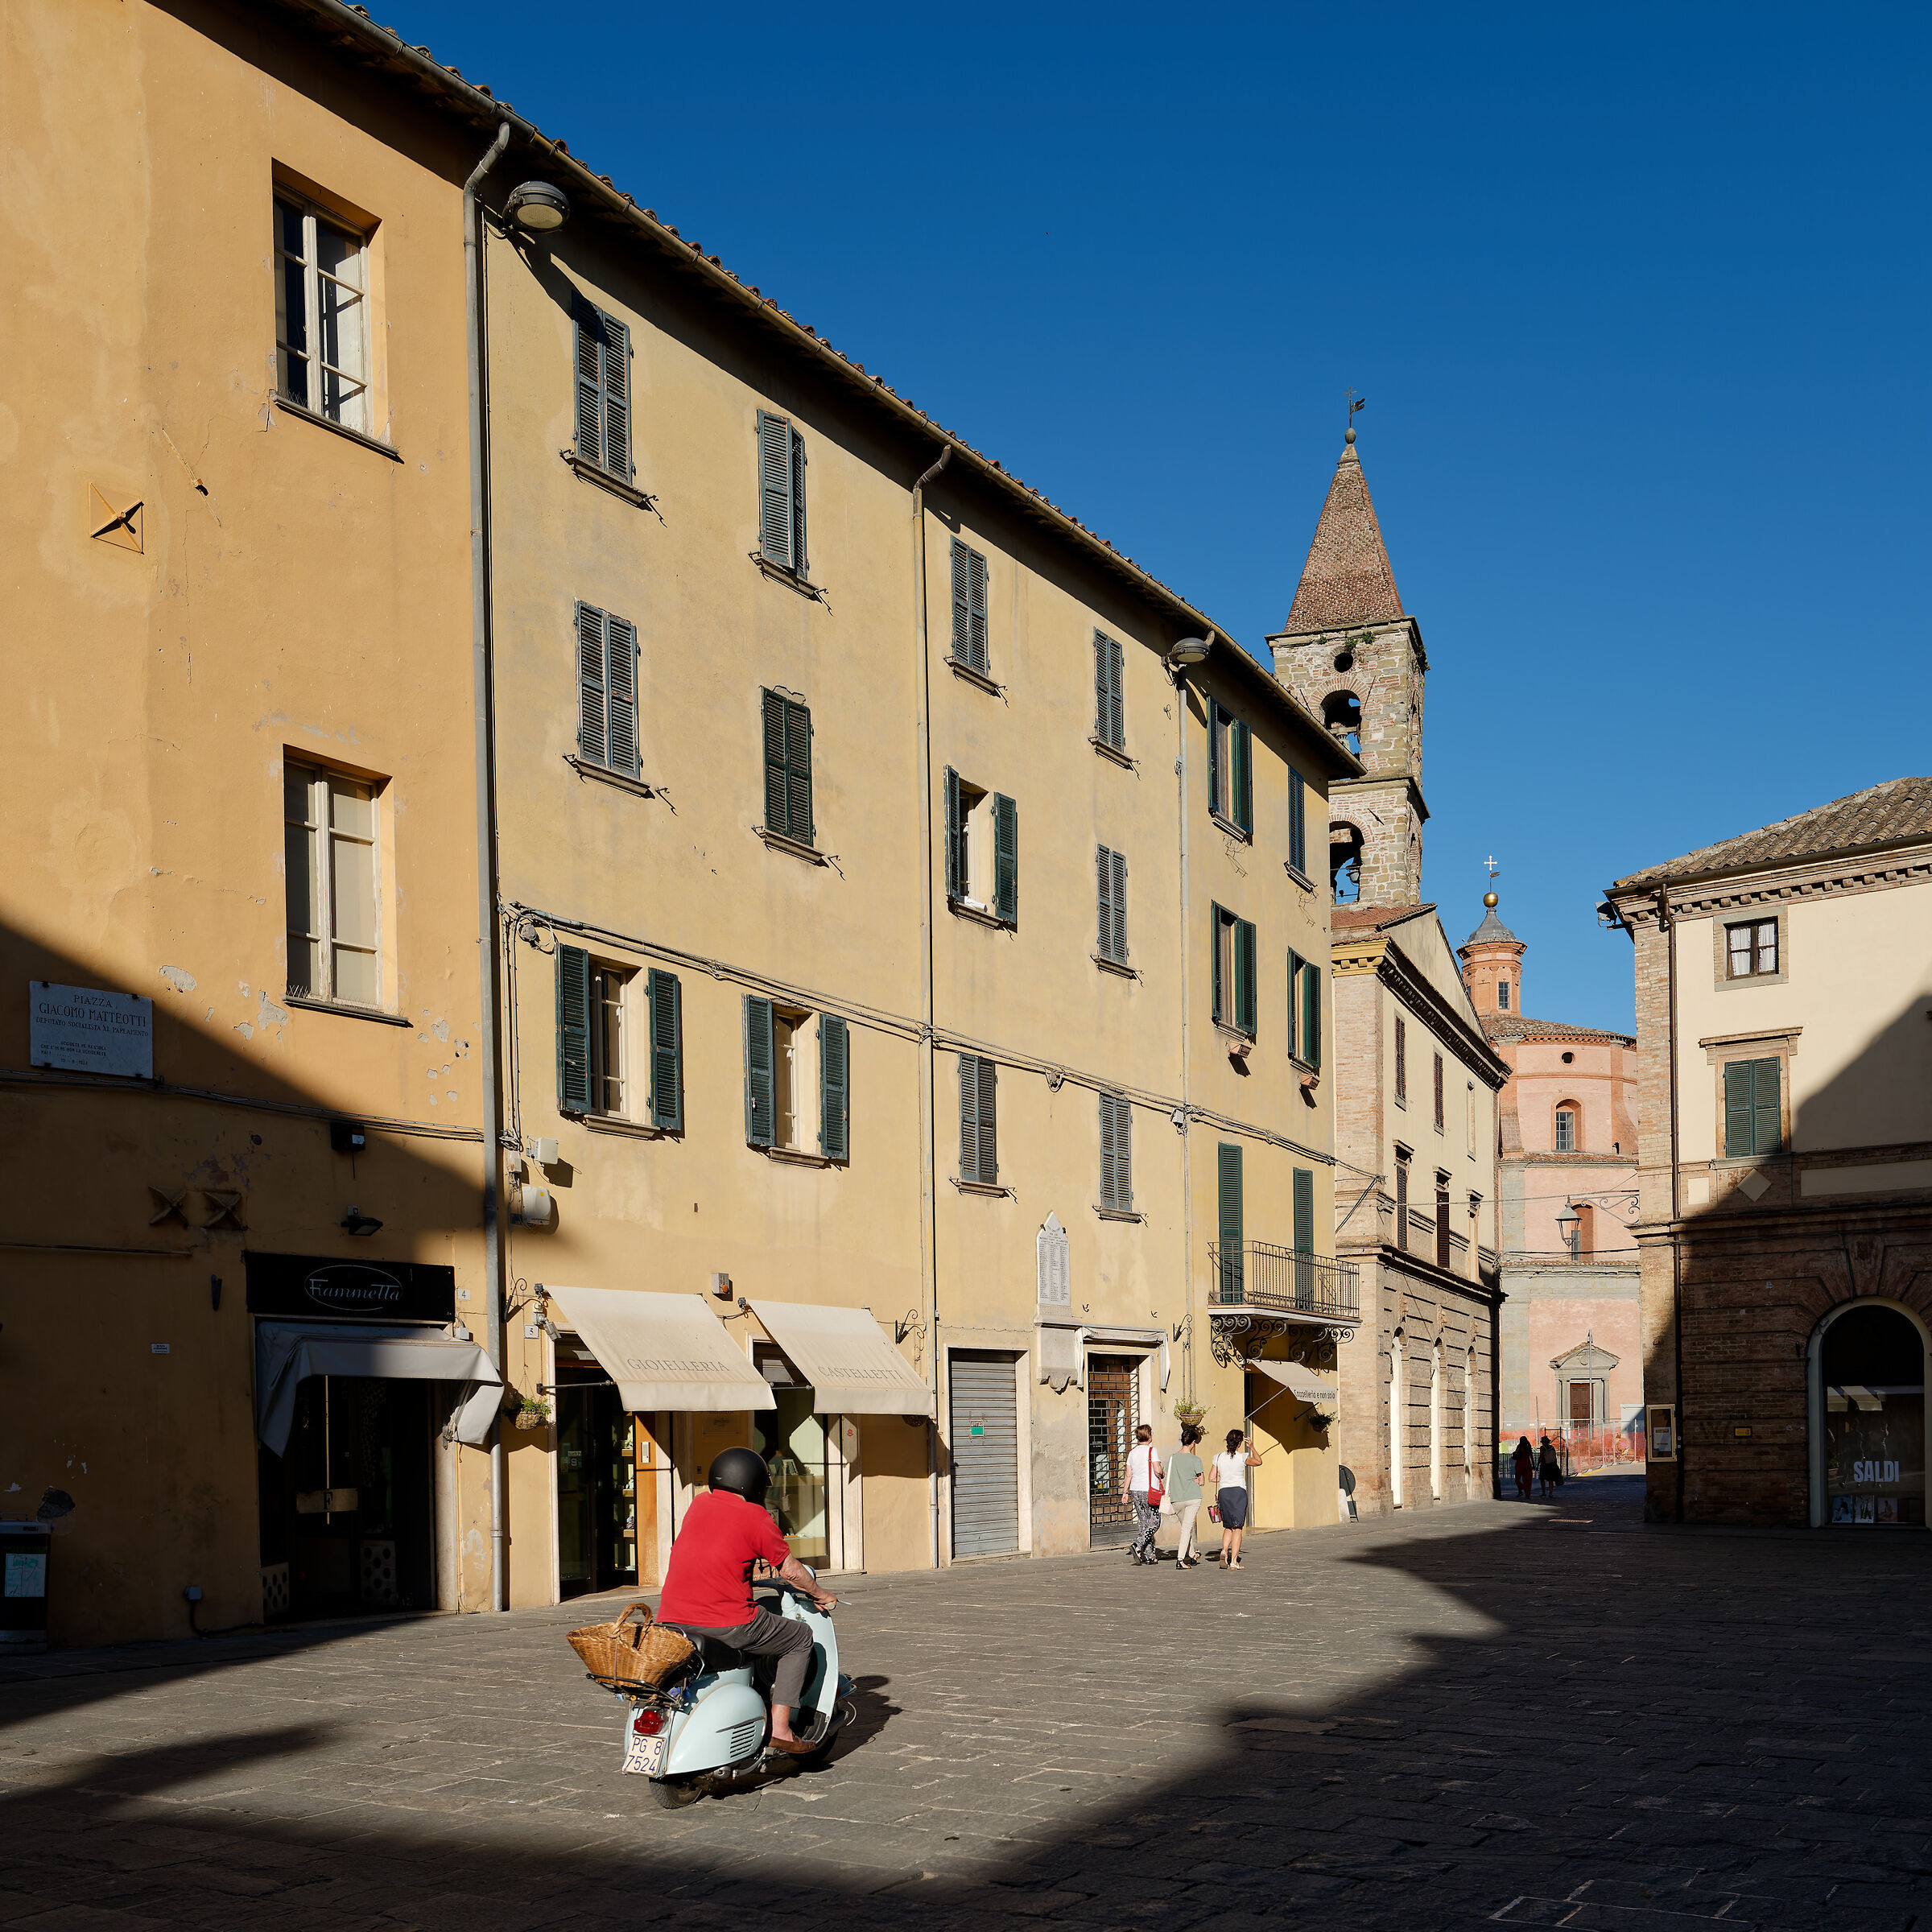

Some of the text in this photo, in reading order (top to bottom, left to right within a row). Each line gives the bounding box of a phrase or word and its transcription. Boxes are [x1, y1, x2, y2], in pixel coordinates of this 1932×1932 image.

[74, 995, 113, 1008] PIAZZA
[39, 1003, 146, 1027] GIACOMO MATTEOTTI
[36, 1017, 66, 1026] DEPUTATO
[68, 1021, 101, 1031] SOCIALISTA
[113, 1026, 149, 1037] PARLAMENTO
[309, 1278, 401, 1301] Fiammetta
[461, 1290, 467, 1298] 4
[530, 1327, 534, 1335] 5
[627, 1358, 730, 1372] GIOIELLERIA
[818, 1366, 903, 1380] CASTELLETTI
[1853, 1460, 1900, 1483] SALDI
[322, 1491, 333, 1510] F
[632, 1737, 663, 1756] PG 8
[625, 1755, 657, 1772] 7524
